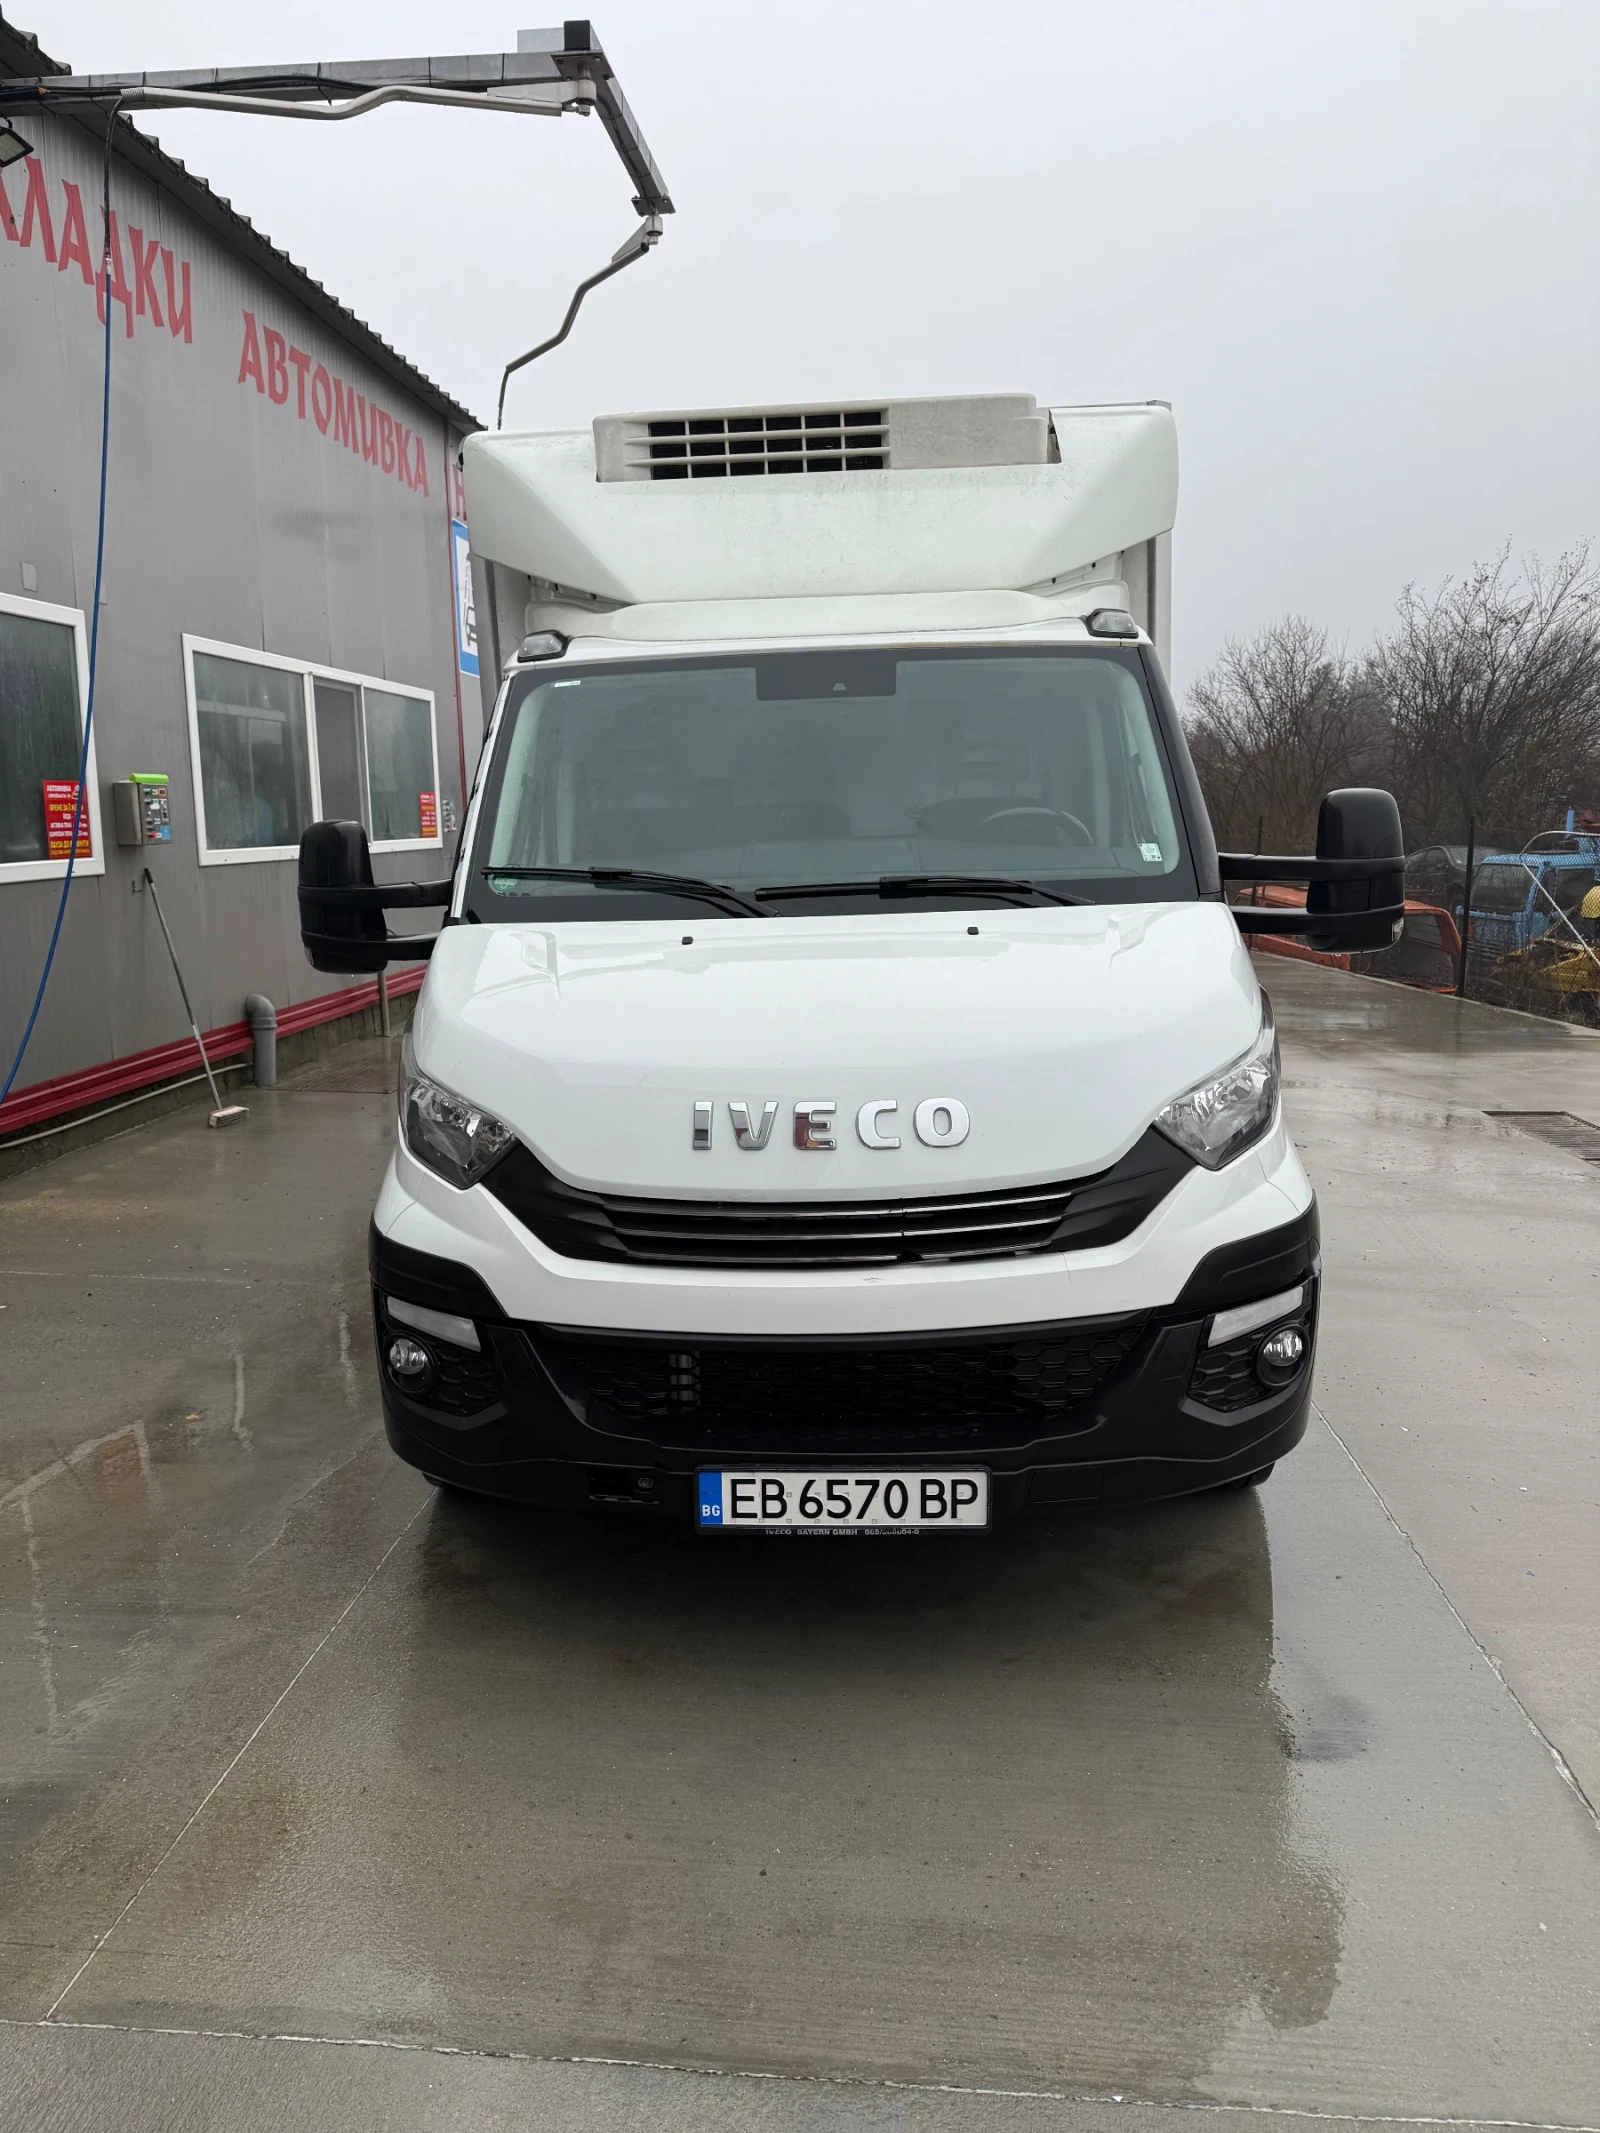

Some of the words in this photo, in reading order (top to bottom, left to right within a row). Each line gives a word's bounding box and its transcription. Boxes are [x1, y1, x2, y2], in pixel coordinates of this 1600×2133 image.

[0, 155, 193, 344] ЛАДКИ
[237, 308, 430, 498] АВТОМИВКА
[692, 1097, 971, 1151] IVECO
[701, 1504, 721, 1517] BG
[730, 1478, 788, 1519] EB
[799, 1478, 909, 1520] 6570
[919, 1478, 979, 1519] BP
[796, 1528, 830, 1536] BAYERN
